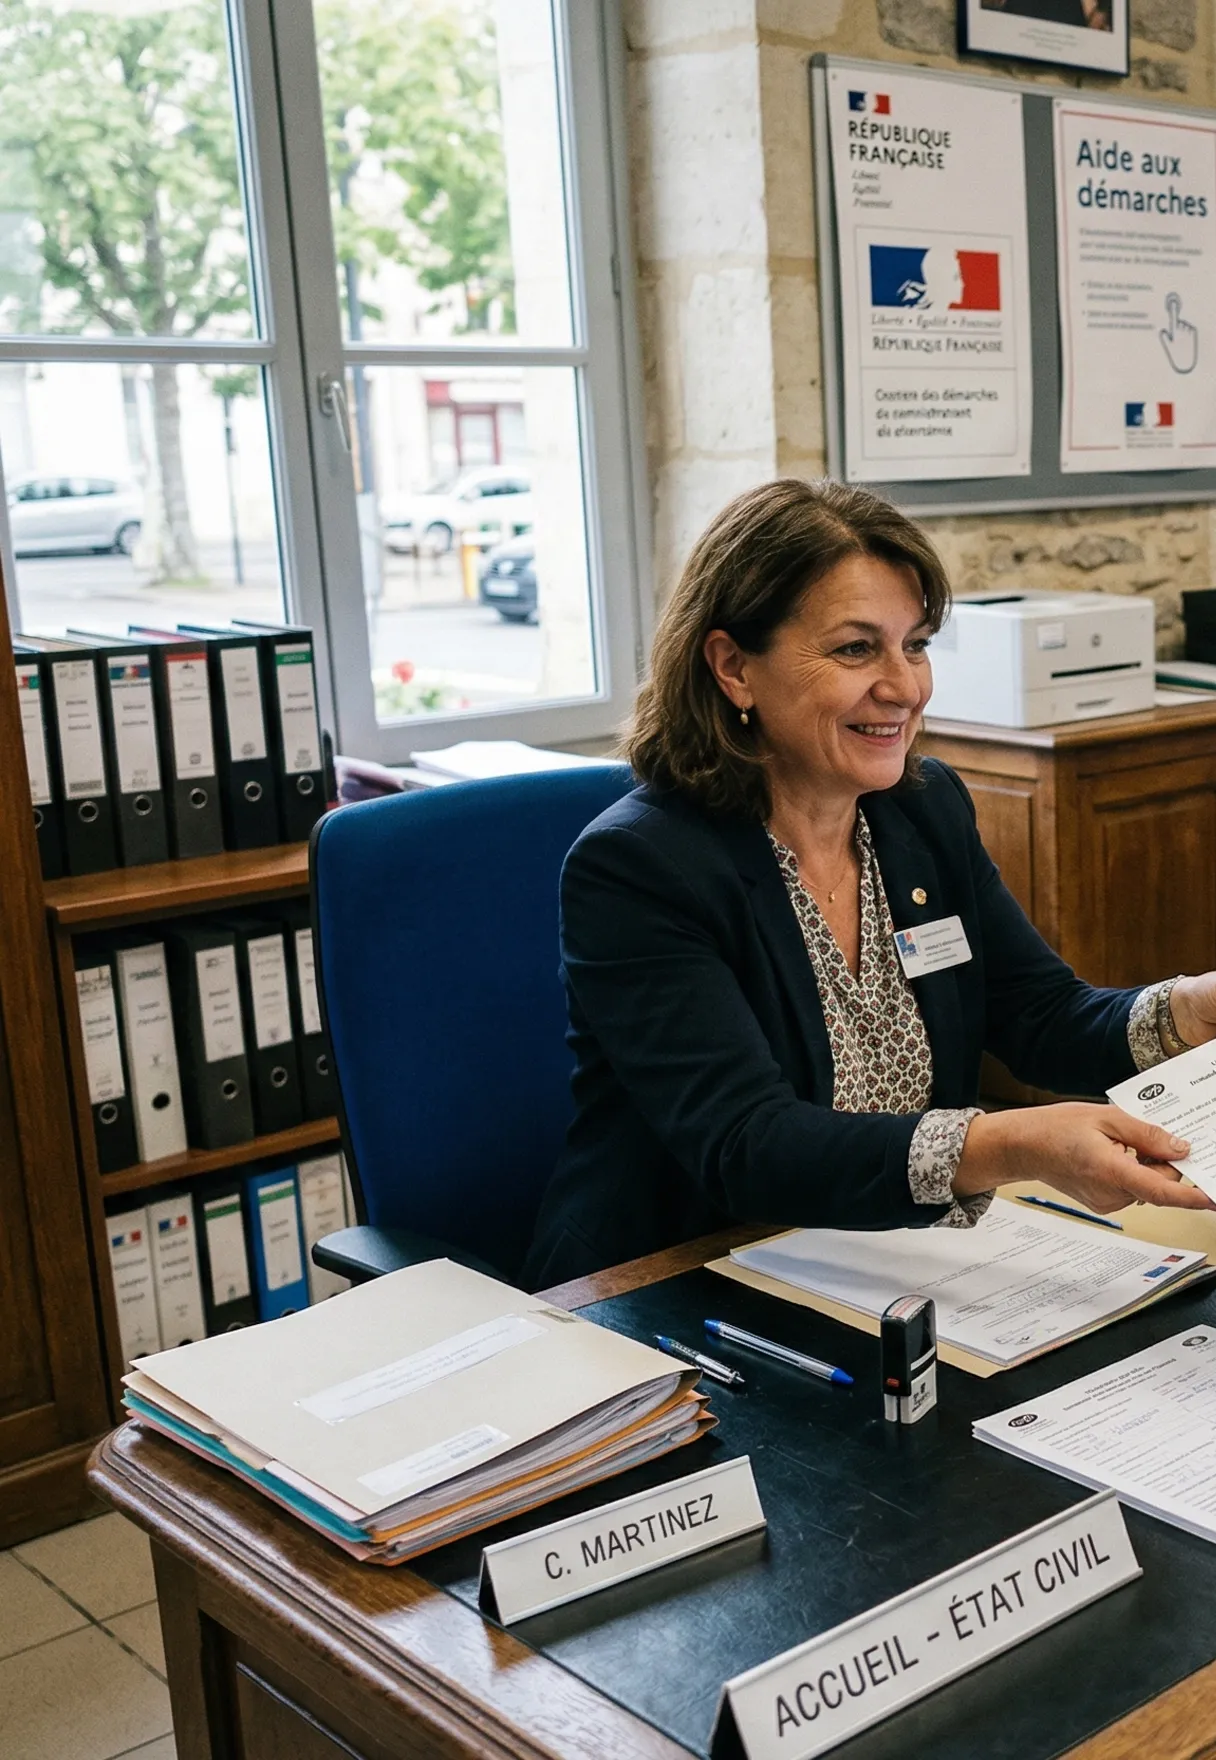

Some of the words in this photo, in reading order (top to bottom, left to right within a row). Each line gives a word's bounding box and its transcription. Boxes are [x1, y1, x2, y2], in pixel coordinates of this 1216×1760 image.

[848, 117, 951, 149] RÉPUBLIQUE
[849, 143, 945, 170] FRANÇAISE
[1076, 139, 1133, 171] Aide
[1141, 152, 1182, 177] aux
[1078, 178, 1208, 217] démarches
[544, 1551, 571, 1579] C.
[580, 1493, 718, 1567] MARTINEZ
[774, 1634, 919, 1737] ACCUEIL
[948, 1570, 1026, 1640] ÉTAT
[1034, 1533, 1111, 1593] CIVIL
